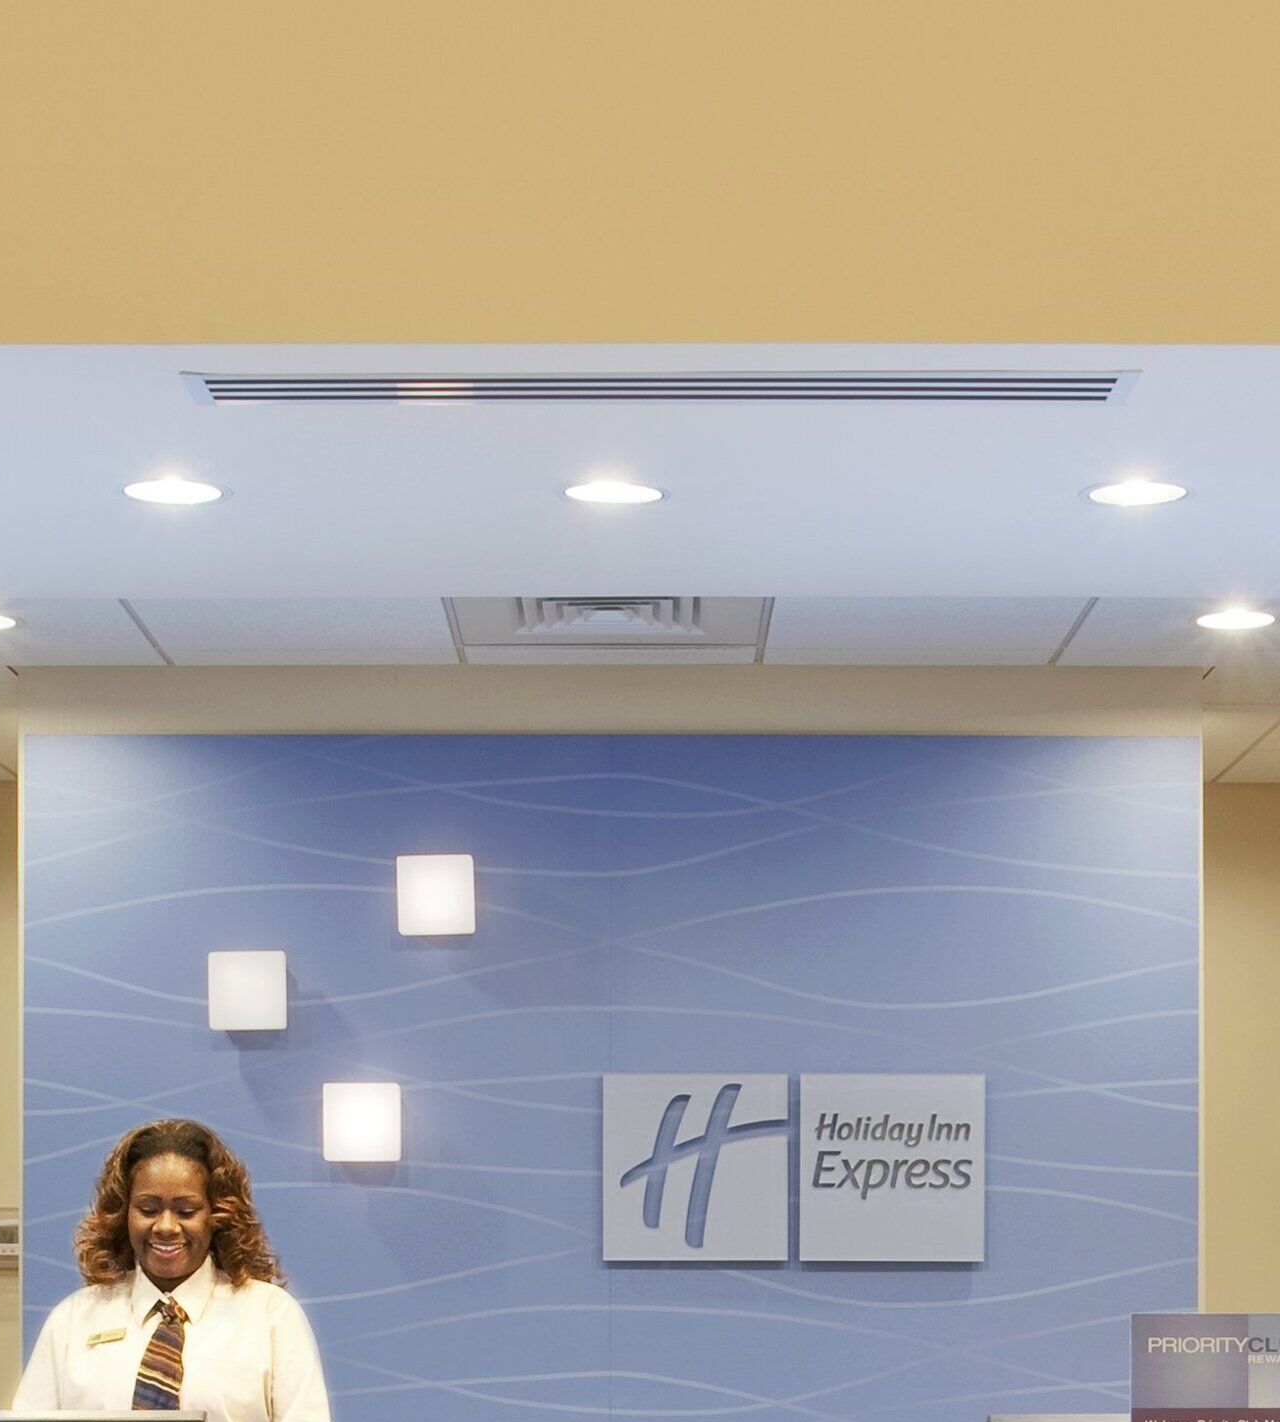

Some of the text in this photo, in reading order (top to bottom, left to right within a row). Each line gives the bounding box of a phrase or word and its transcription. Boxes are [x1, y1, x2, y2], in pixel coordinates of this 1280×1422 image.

[814, 1113, 971, 1147] Holiday Inn
[812, 1150, 973, 1200] Express
